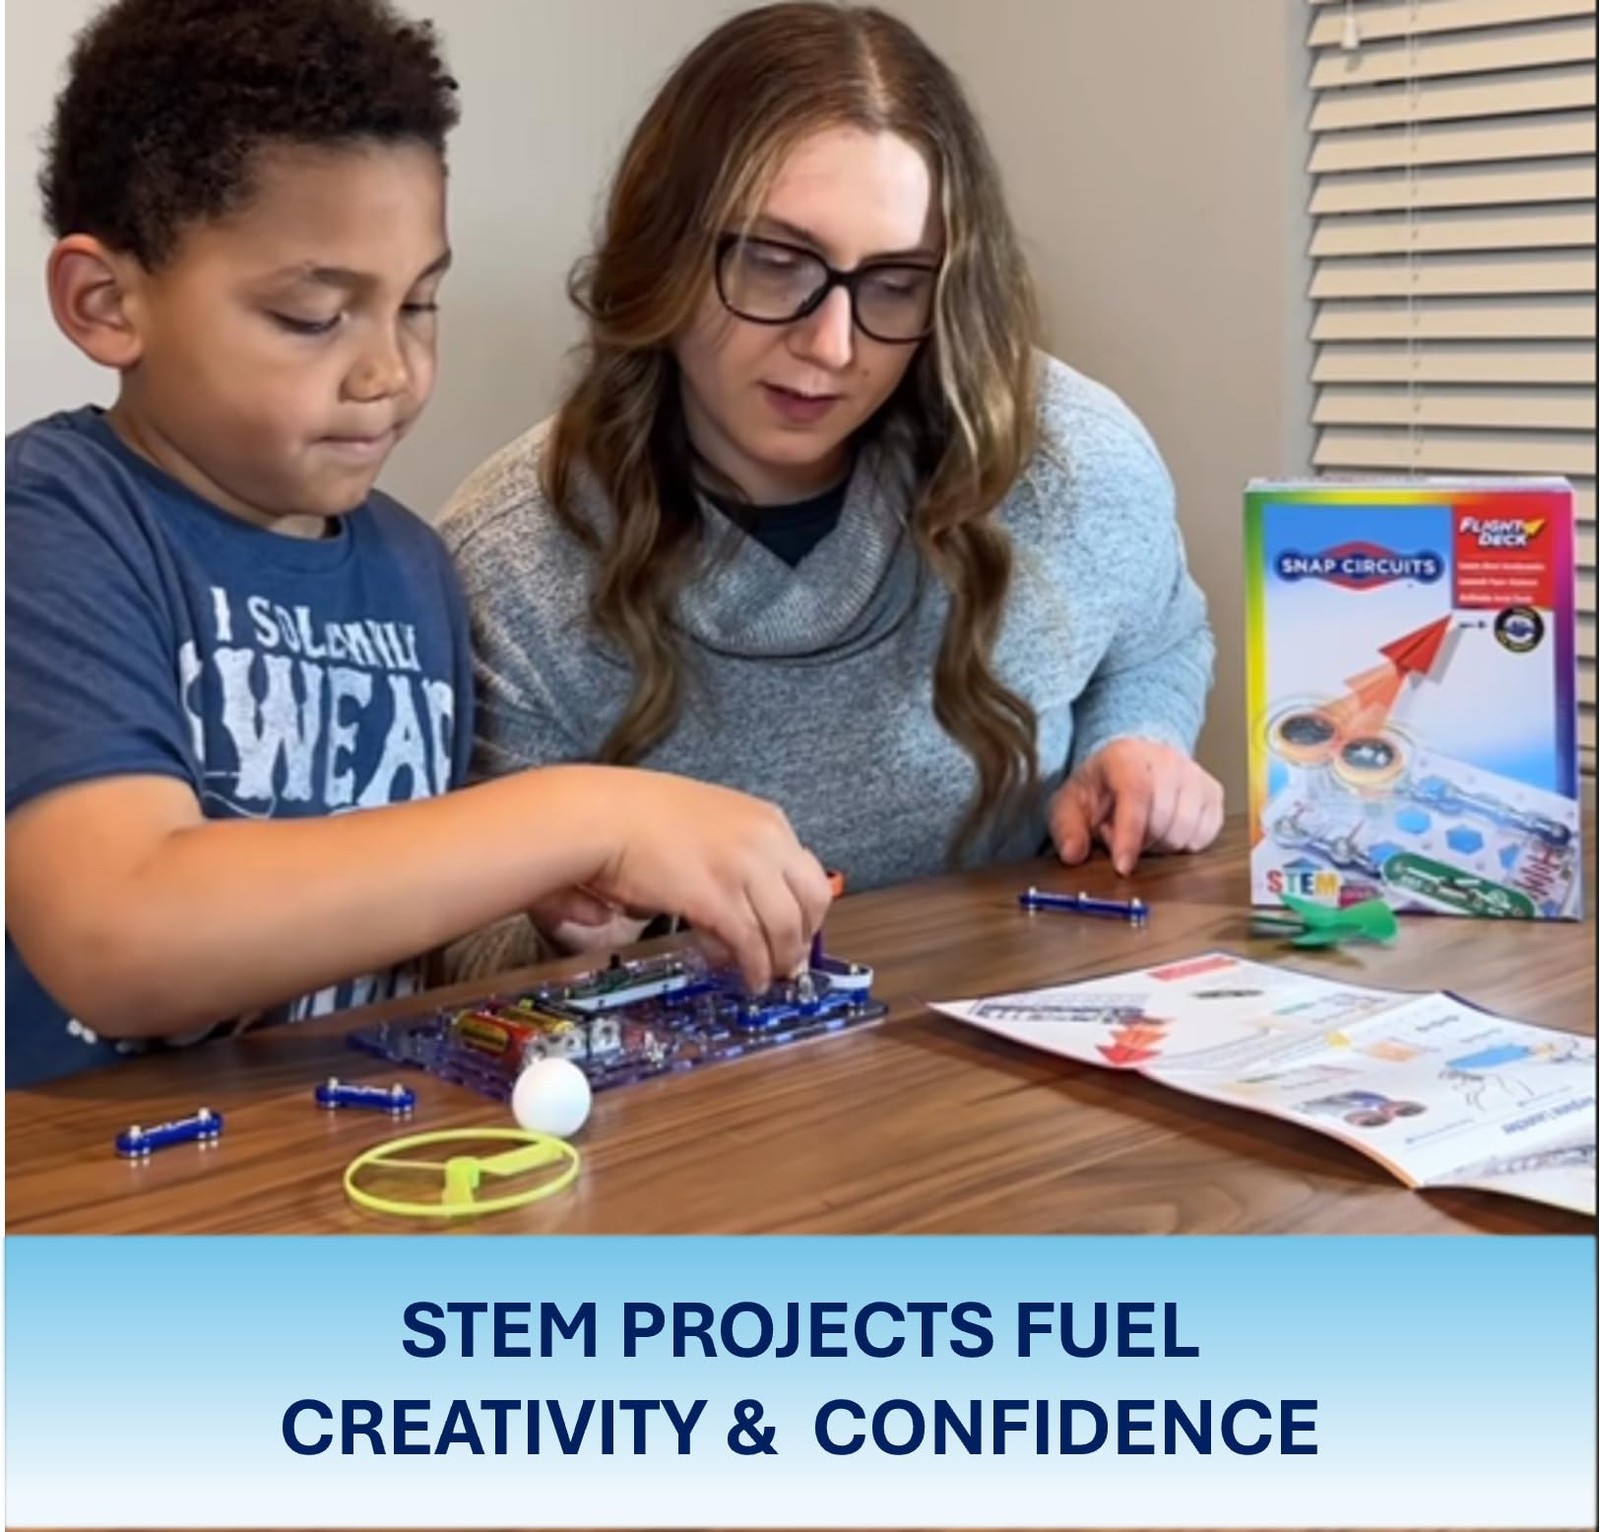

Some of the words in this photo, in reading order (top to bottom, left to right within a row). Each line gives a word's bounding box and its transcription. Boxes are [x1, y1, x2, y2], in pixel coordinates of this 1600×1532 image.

[1459, 516, 1526, 536] FLIGHT
[1478, 533, 1528, 547] DECK
[1281, 558, 1337, 575] SNAP
[1341, 557, 1437, 575] CIRCUITS
[210, 585, 232, 642] I
[1265, 868, 1338, 897] STEM
